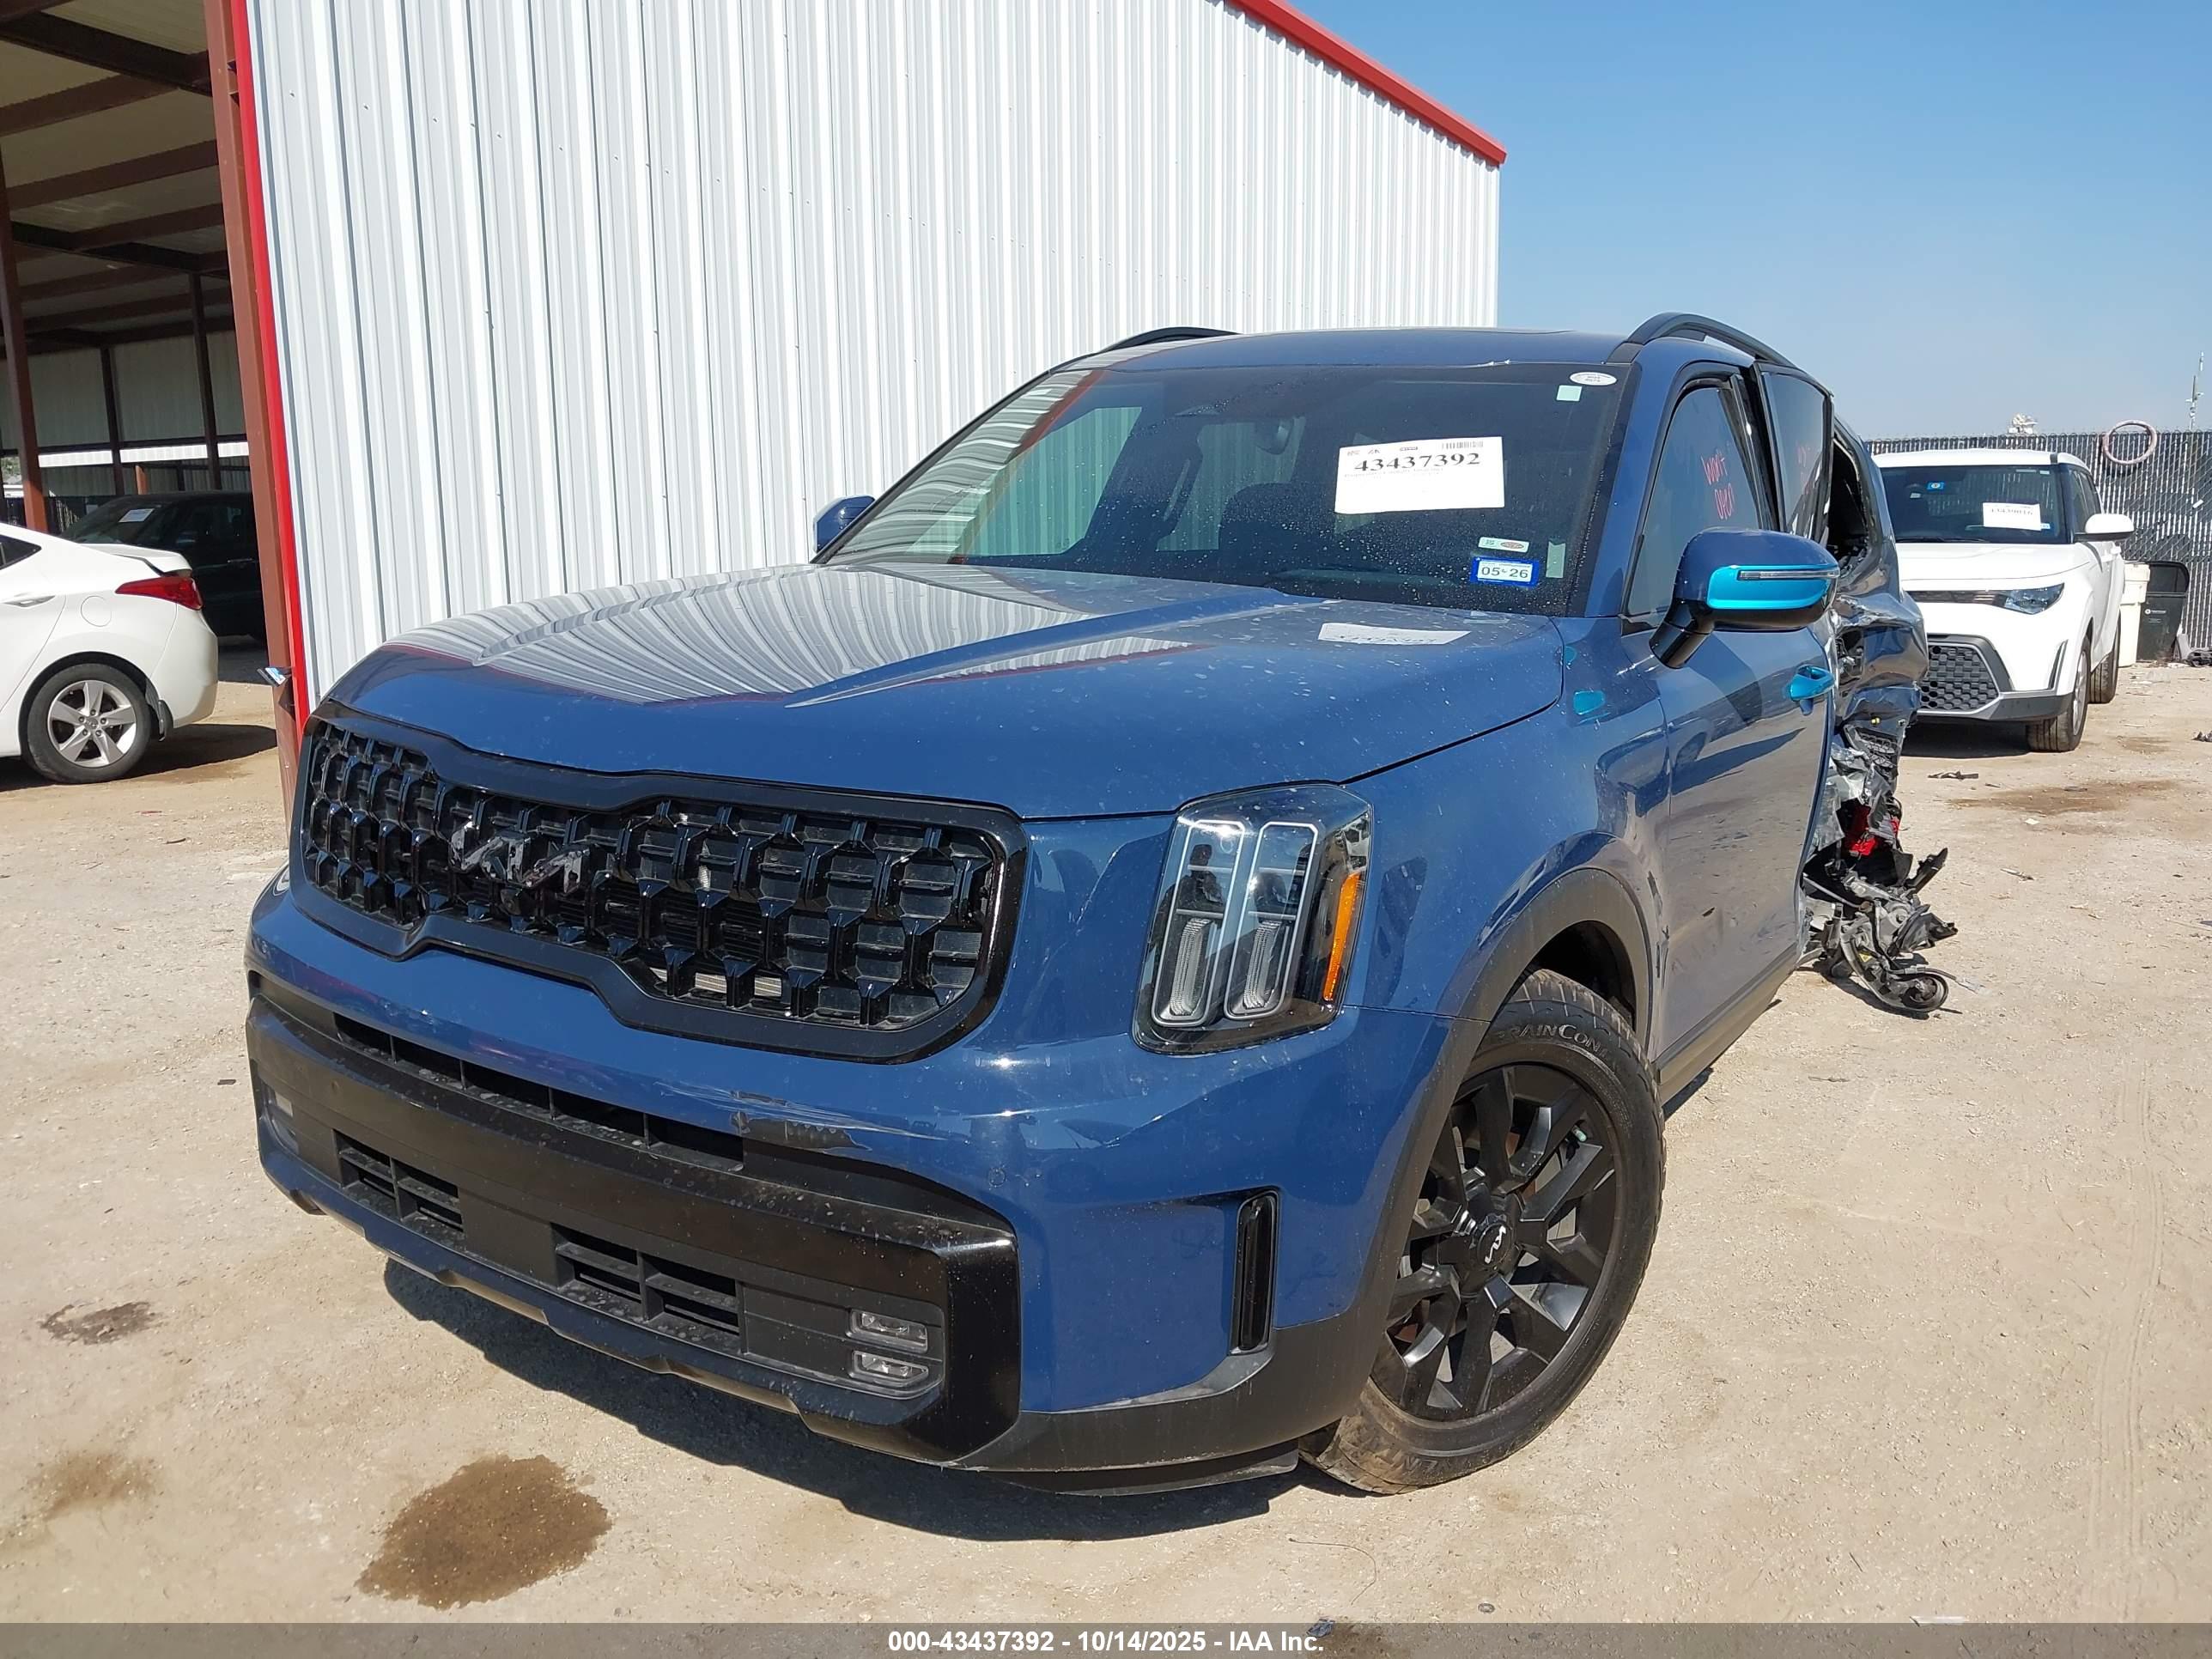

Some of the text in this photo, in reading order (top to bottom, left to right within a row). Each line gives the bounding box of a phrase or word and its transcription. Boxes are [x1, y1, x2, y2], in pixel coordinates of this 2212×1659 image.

[1354, 453, 1480, 471] 43437392
[1481, 567, 1528, 578] 05 26
